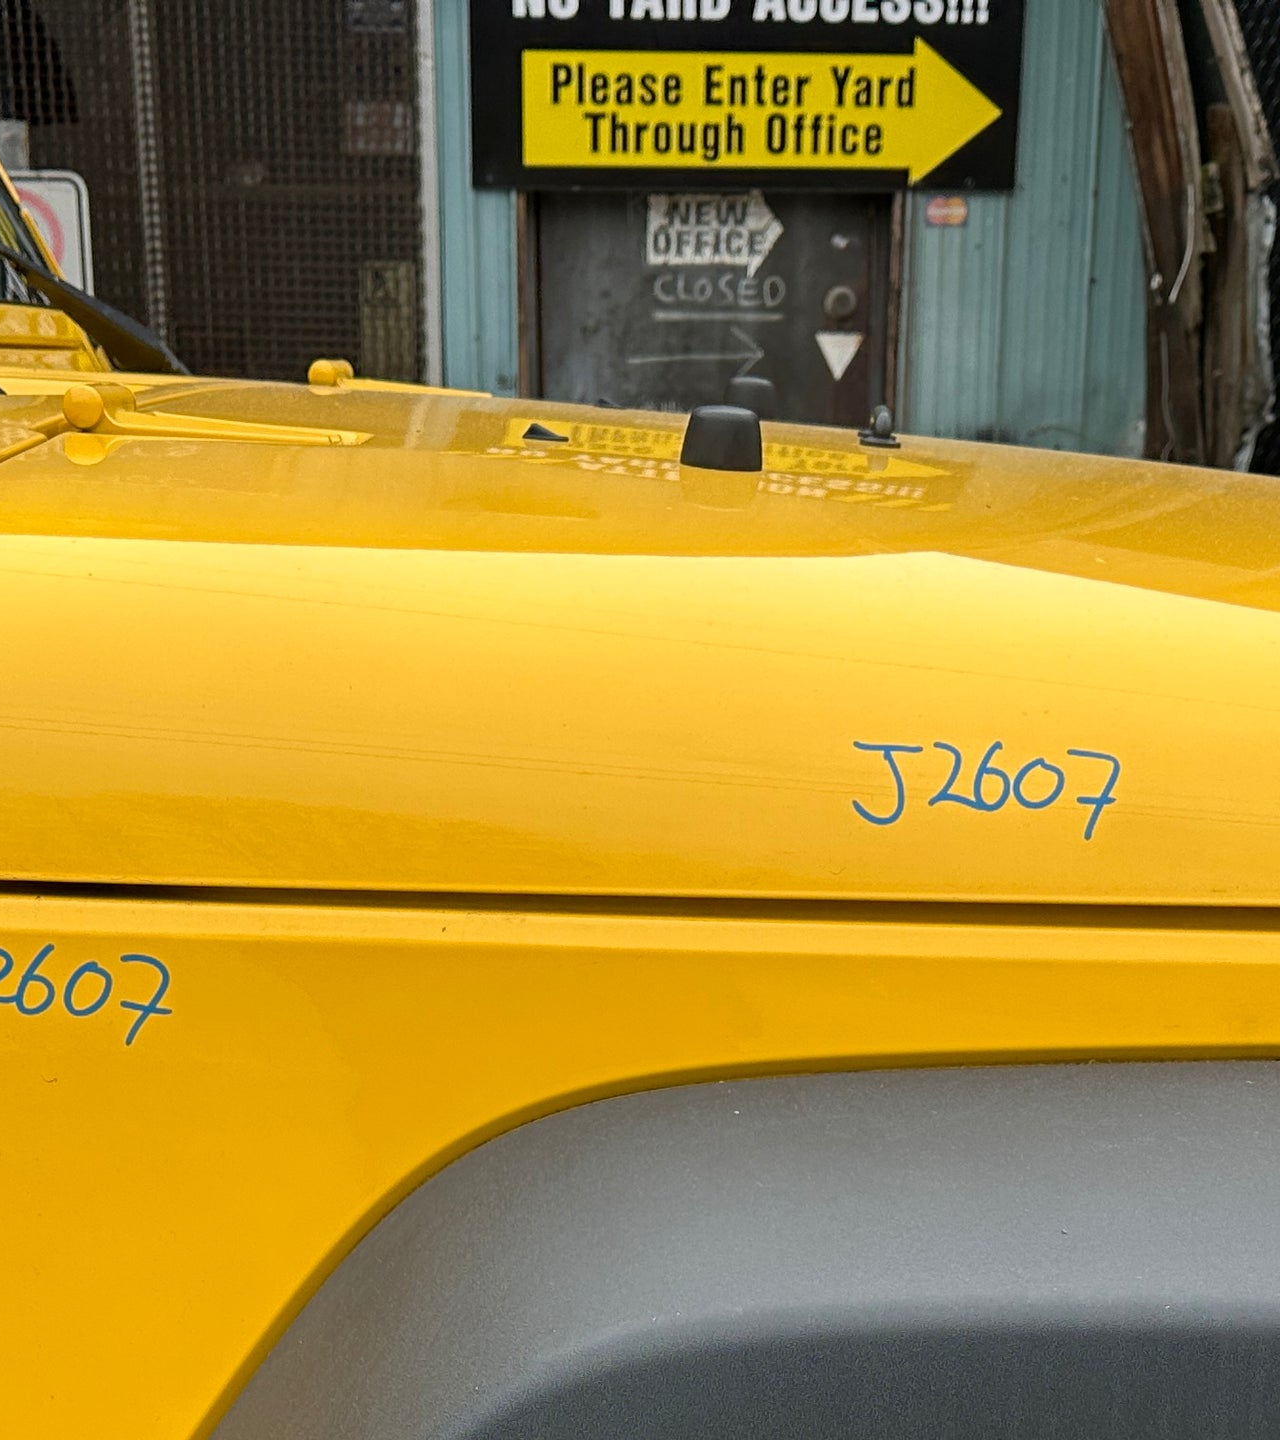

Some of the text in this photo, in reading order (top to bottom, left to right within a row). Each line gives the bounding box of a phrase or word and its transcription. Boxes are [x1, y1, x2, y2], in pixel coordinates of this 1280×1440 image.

[551, 63, 916, 108] Please Enter Yard
[584, 112, 884, 161] Through Office
[668, 199, 748, 225] NEW
[653, 225, 765, 257] OFFICE
[852, 740, 1121, 841] J2607
